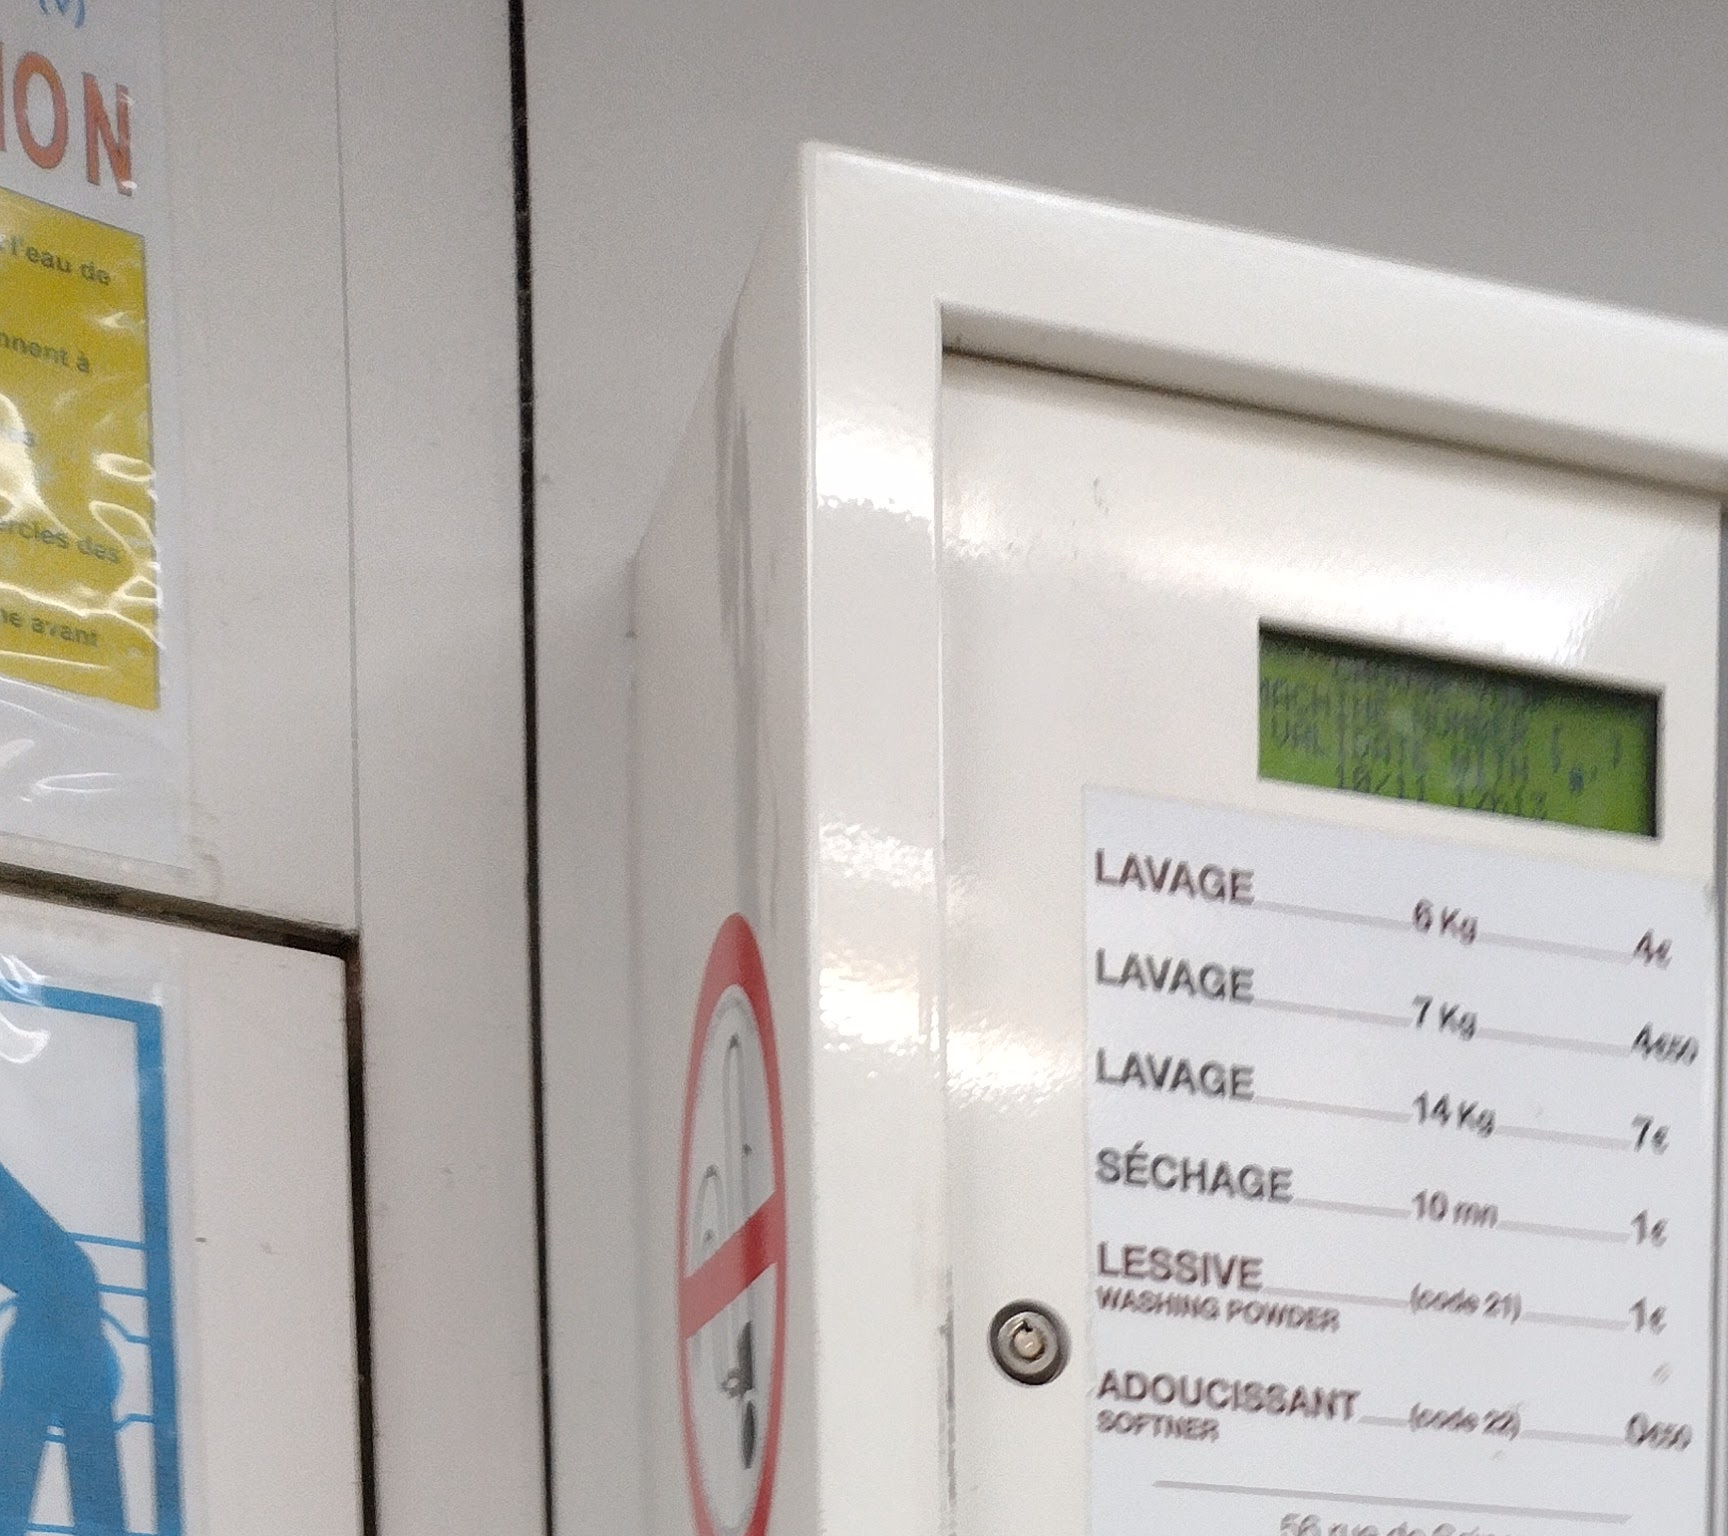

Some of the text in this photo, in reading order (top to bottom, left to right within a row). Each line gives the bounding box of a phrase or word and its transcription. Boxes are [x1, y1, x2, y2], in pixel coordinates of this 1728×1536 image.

[0, 42, 132, 197] ON
[1095, 847, 1255, 906] LAVAGE
[1095, 947, 1255, 1004] LAVAGE
[1095, 1046, 1255, 1101] LAVAGE
[1411, 1089, 1451, 1127] 14
[1095, 1139, 1295, 1204] SÉCHAGE
[1411, 1188, 1450, 1222] 10
[1096, 1240, 1264, 1293] LESSIVE
[1095, 1284, 1341, 1334] WASHING POWDER
[1097, 1367, 1362, 1422] ADOUCISSANT
[1096, 1407, 1220, 1443] SOFTNER
